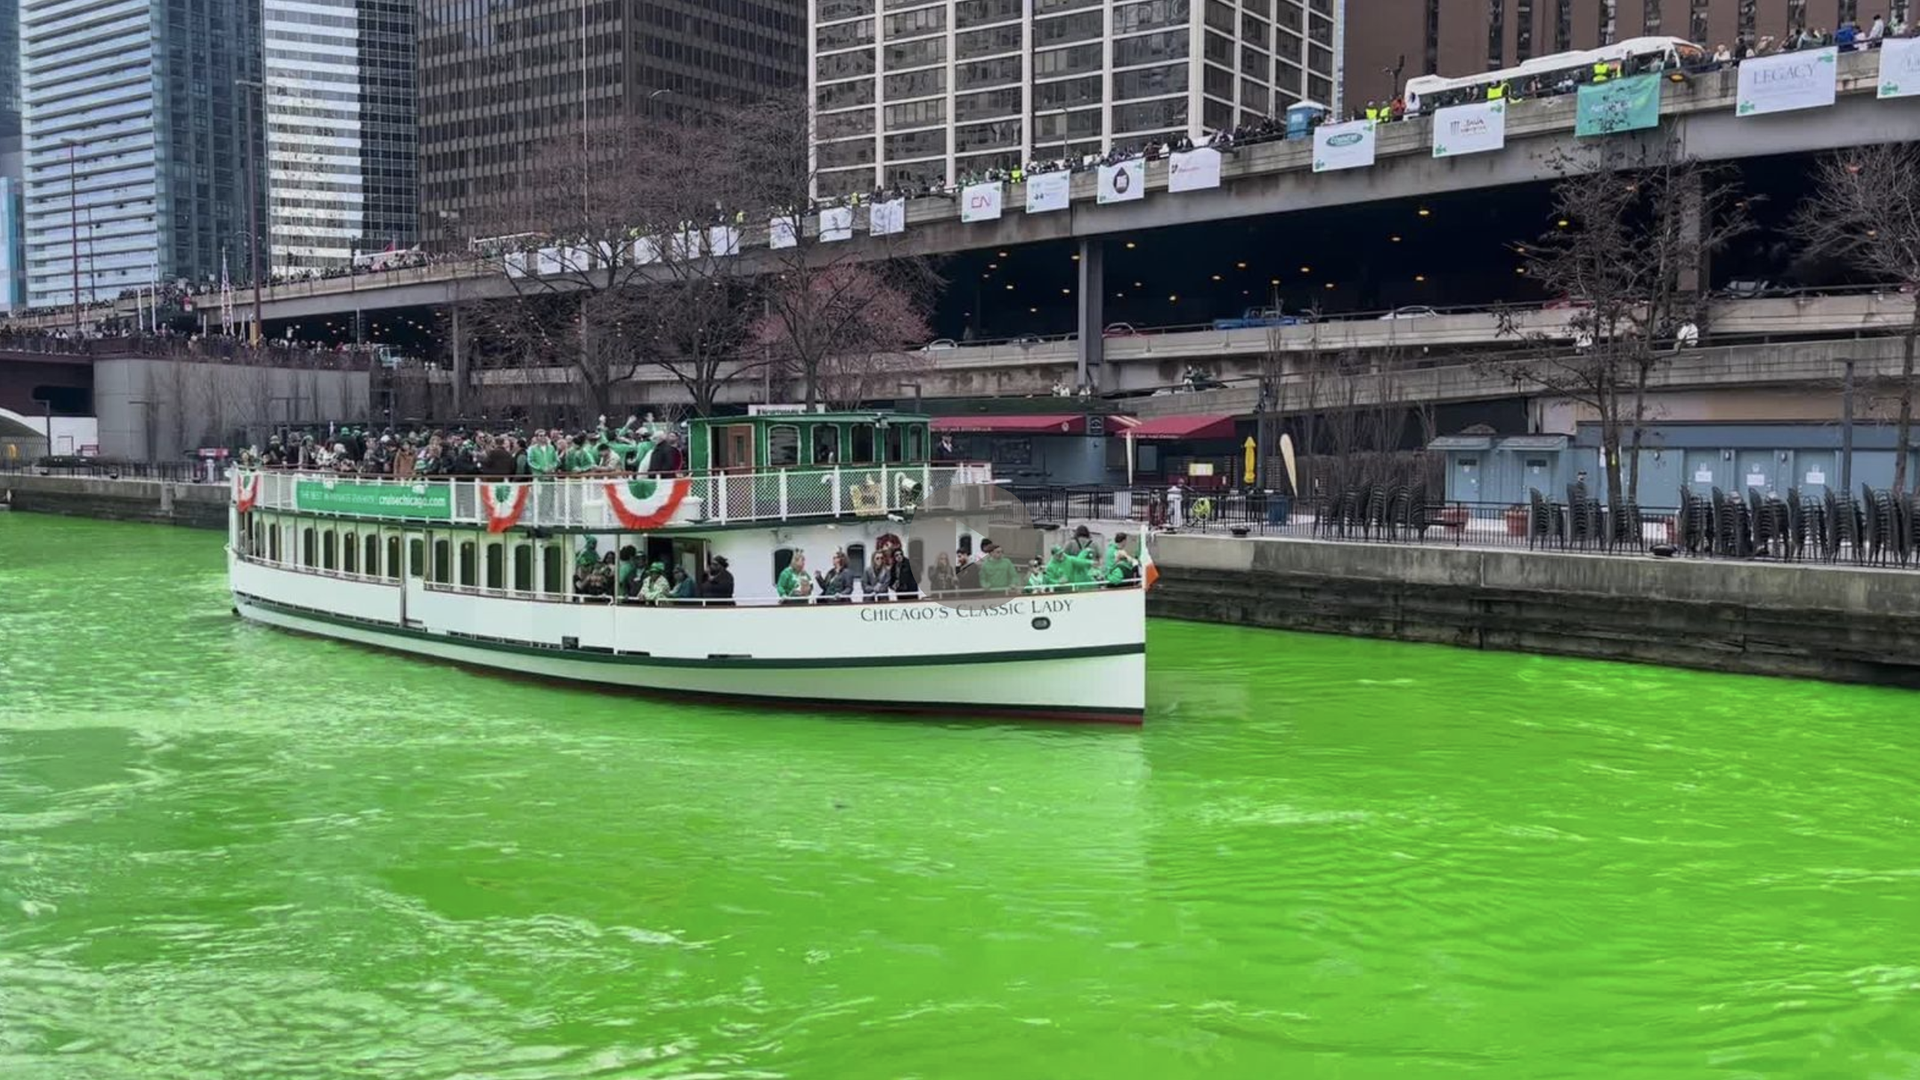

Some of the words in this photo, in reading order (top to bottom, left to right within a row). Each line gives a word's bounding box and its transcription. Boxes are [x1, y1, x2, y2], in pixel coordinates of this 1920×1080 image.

[1753, 63, 1815, 84] LEGACY
[379, 493, 445, 508] cruisechicago.com
[860, 606, 949, 622] CHICAGO'S
[956, 602, 1026, 617] CLASSIC
[1031, 599, 1073, 614] LADY
